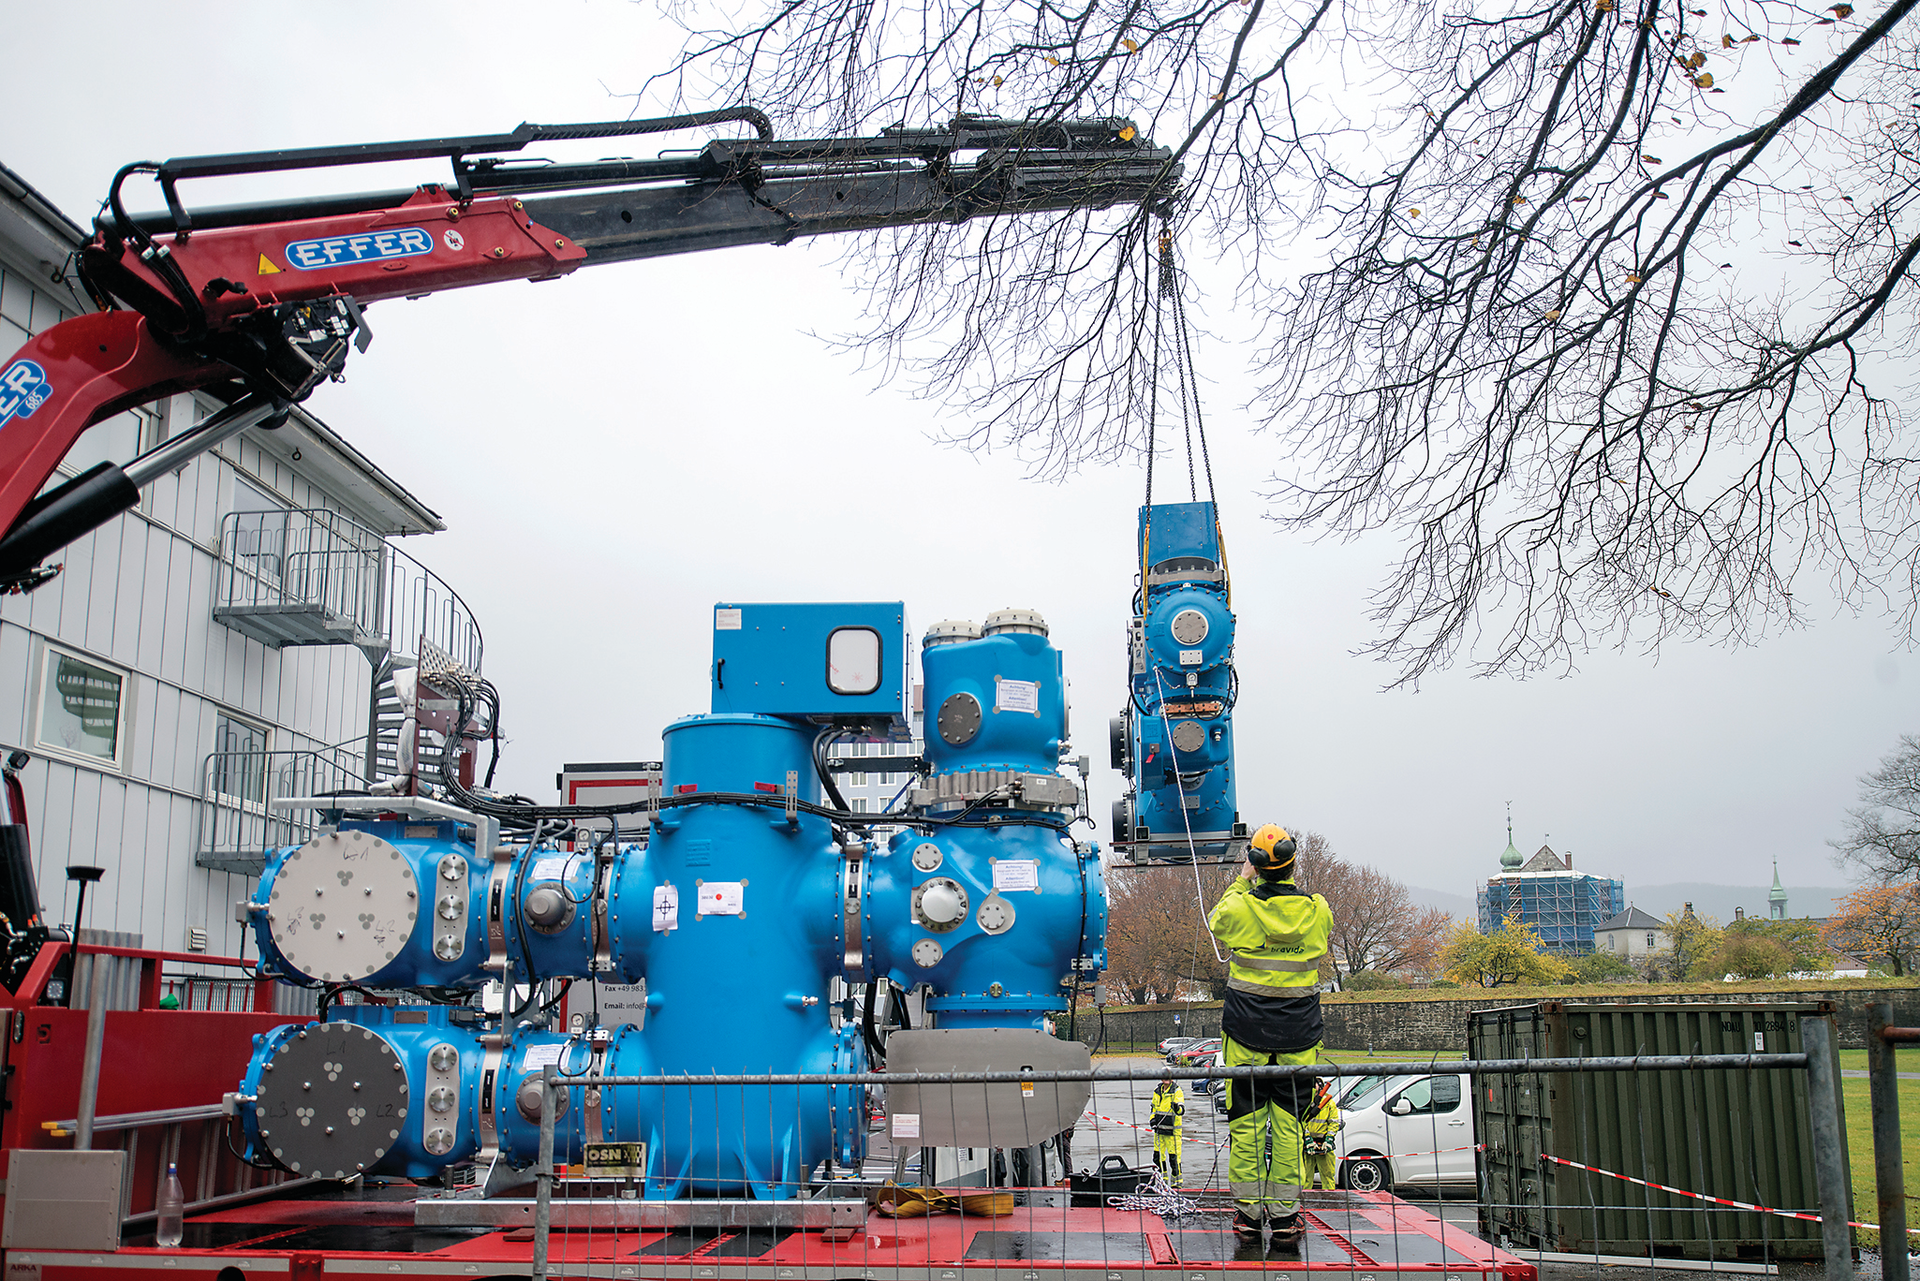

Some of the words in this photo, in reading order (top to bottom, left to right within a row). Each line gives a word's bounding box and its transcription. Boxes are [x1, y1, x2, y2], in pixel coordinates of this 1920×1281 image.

[296, 231, 428, 266] EFFER
[25, 391, 43, 409] 685
[376, 1103, 396, 1118] L2
[588, 1149, 621, 1160] OSN
